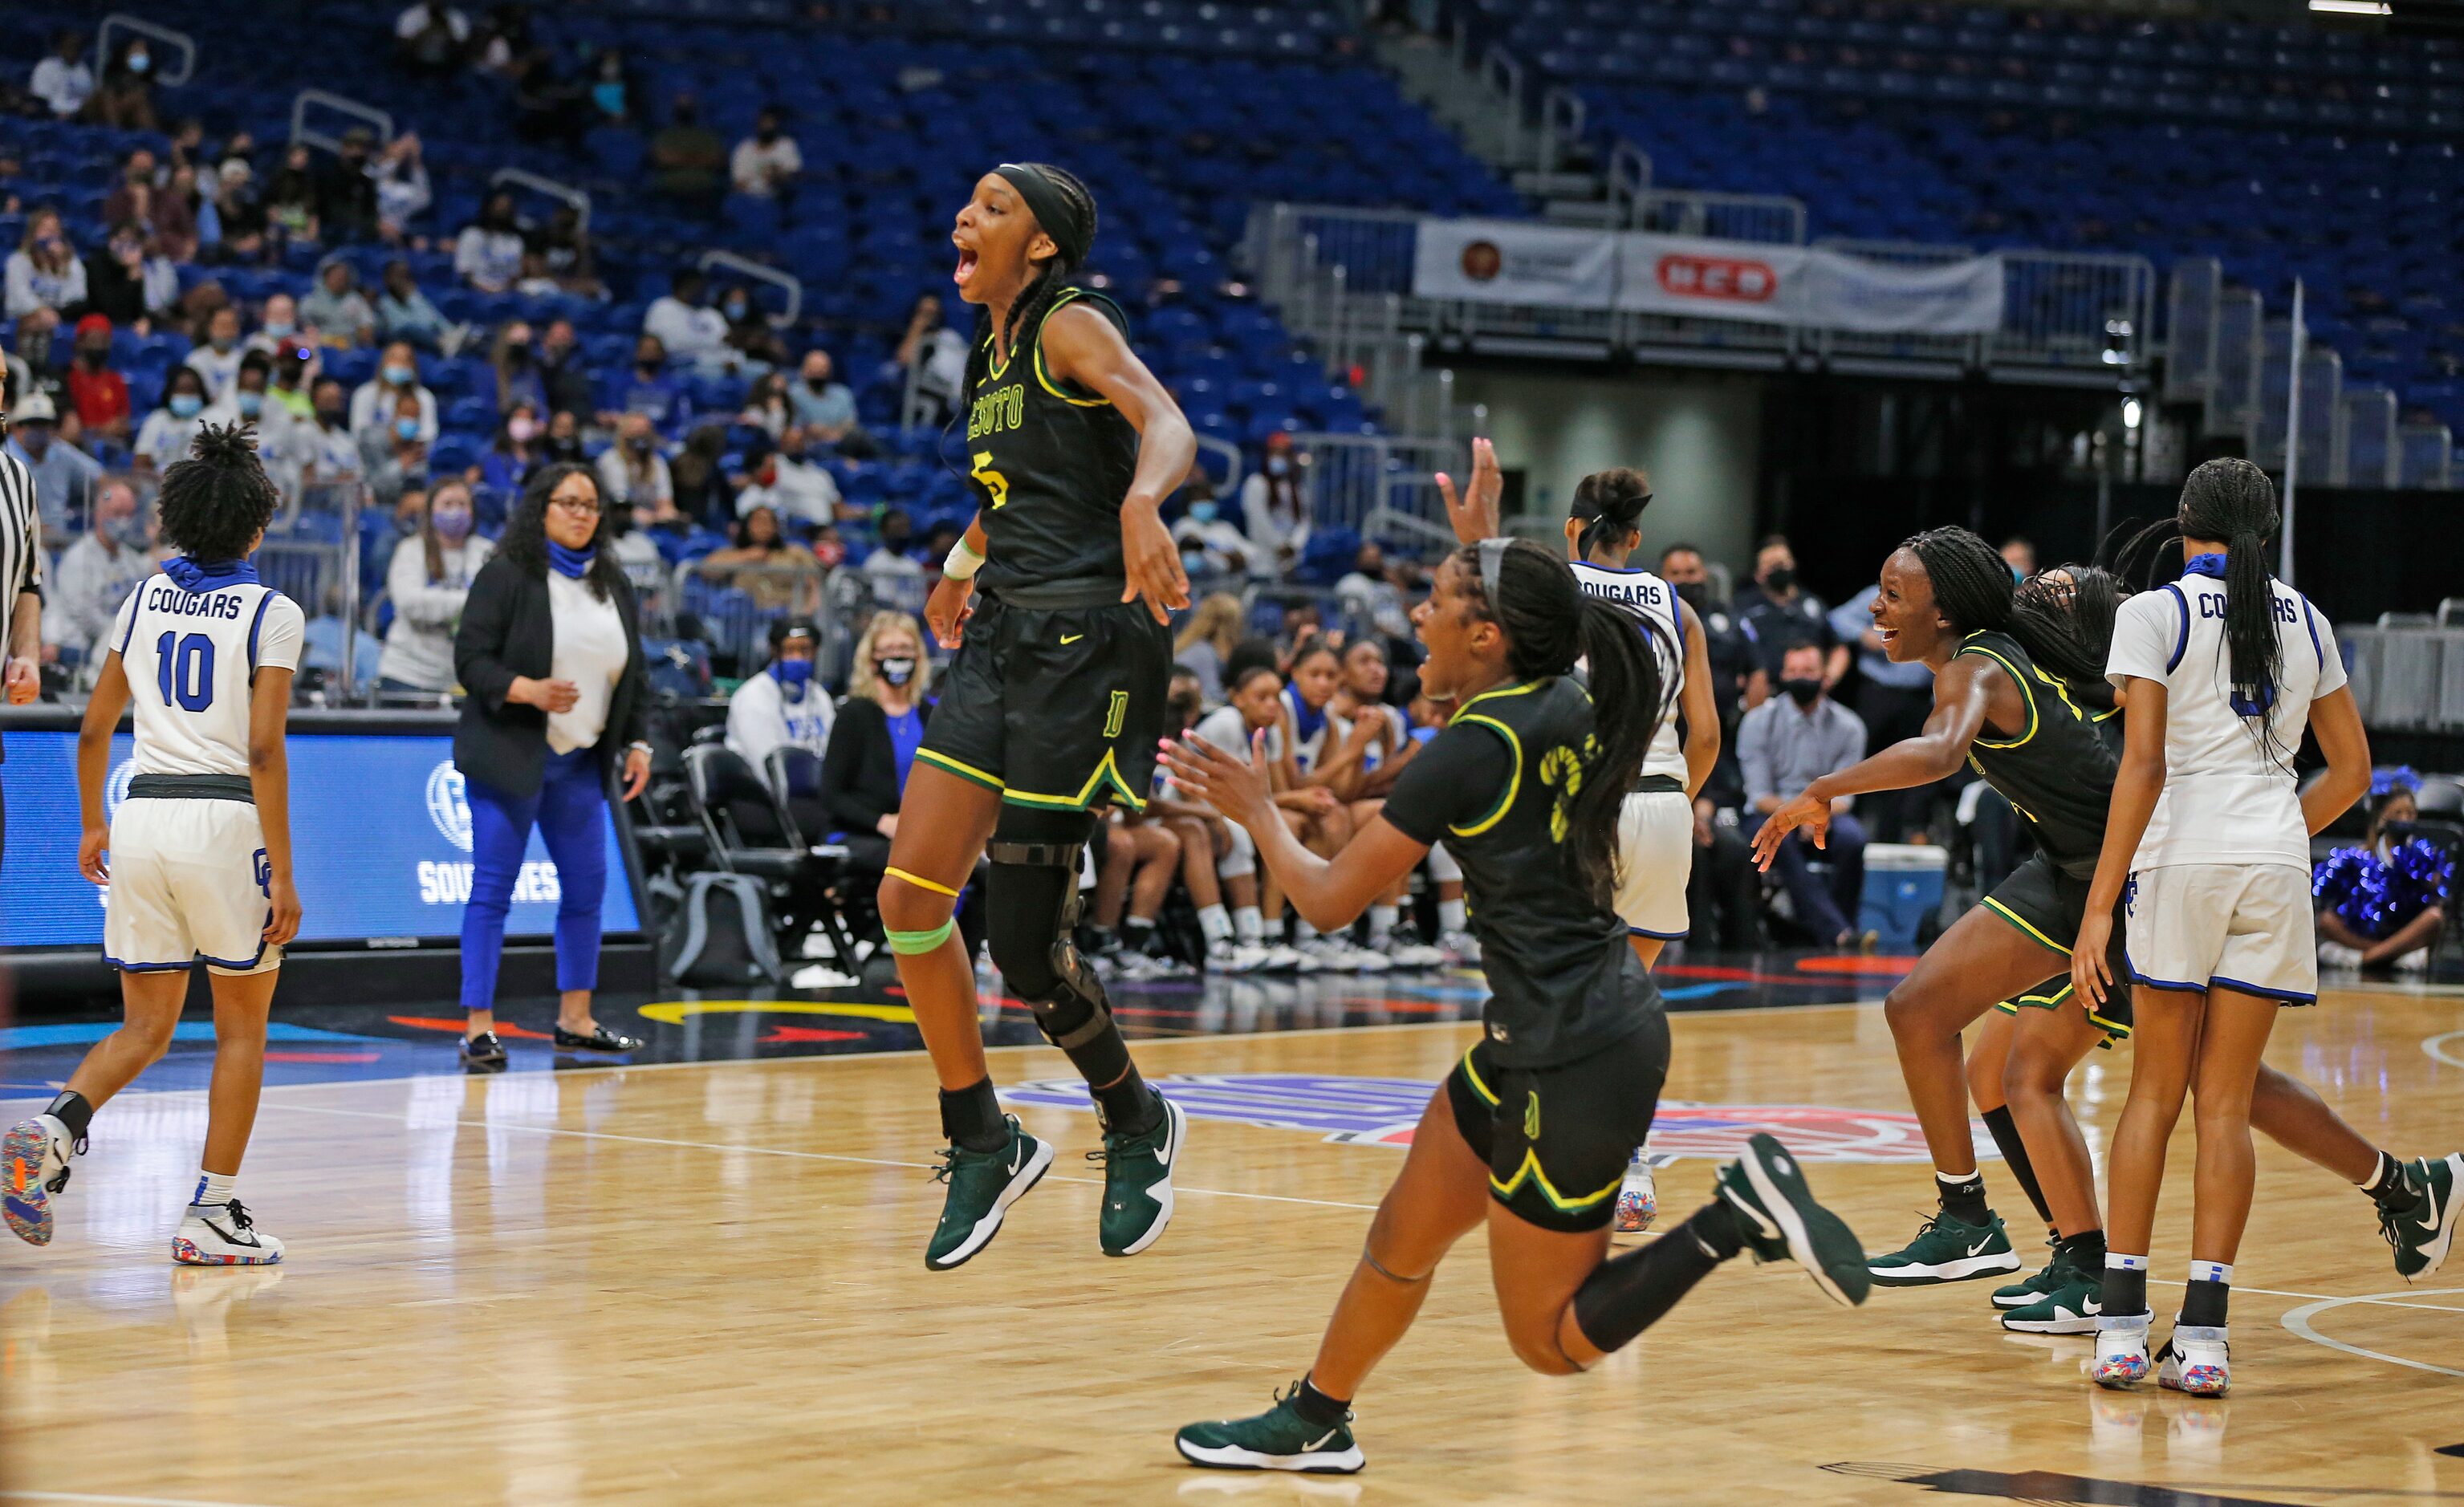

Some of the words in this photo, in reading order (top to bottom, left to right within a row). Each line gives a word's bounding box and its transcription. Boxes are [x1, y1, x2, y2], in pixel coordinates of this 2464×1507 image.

[971, 450, 1010, 510] 5
[148, 587, 242, 620] COUGARS
[1579, 581, 1661, 605] OUGARS
[2198, 592, 2298, 624] CORS
[157, 630, 215, 713] 10
